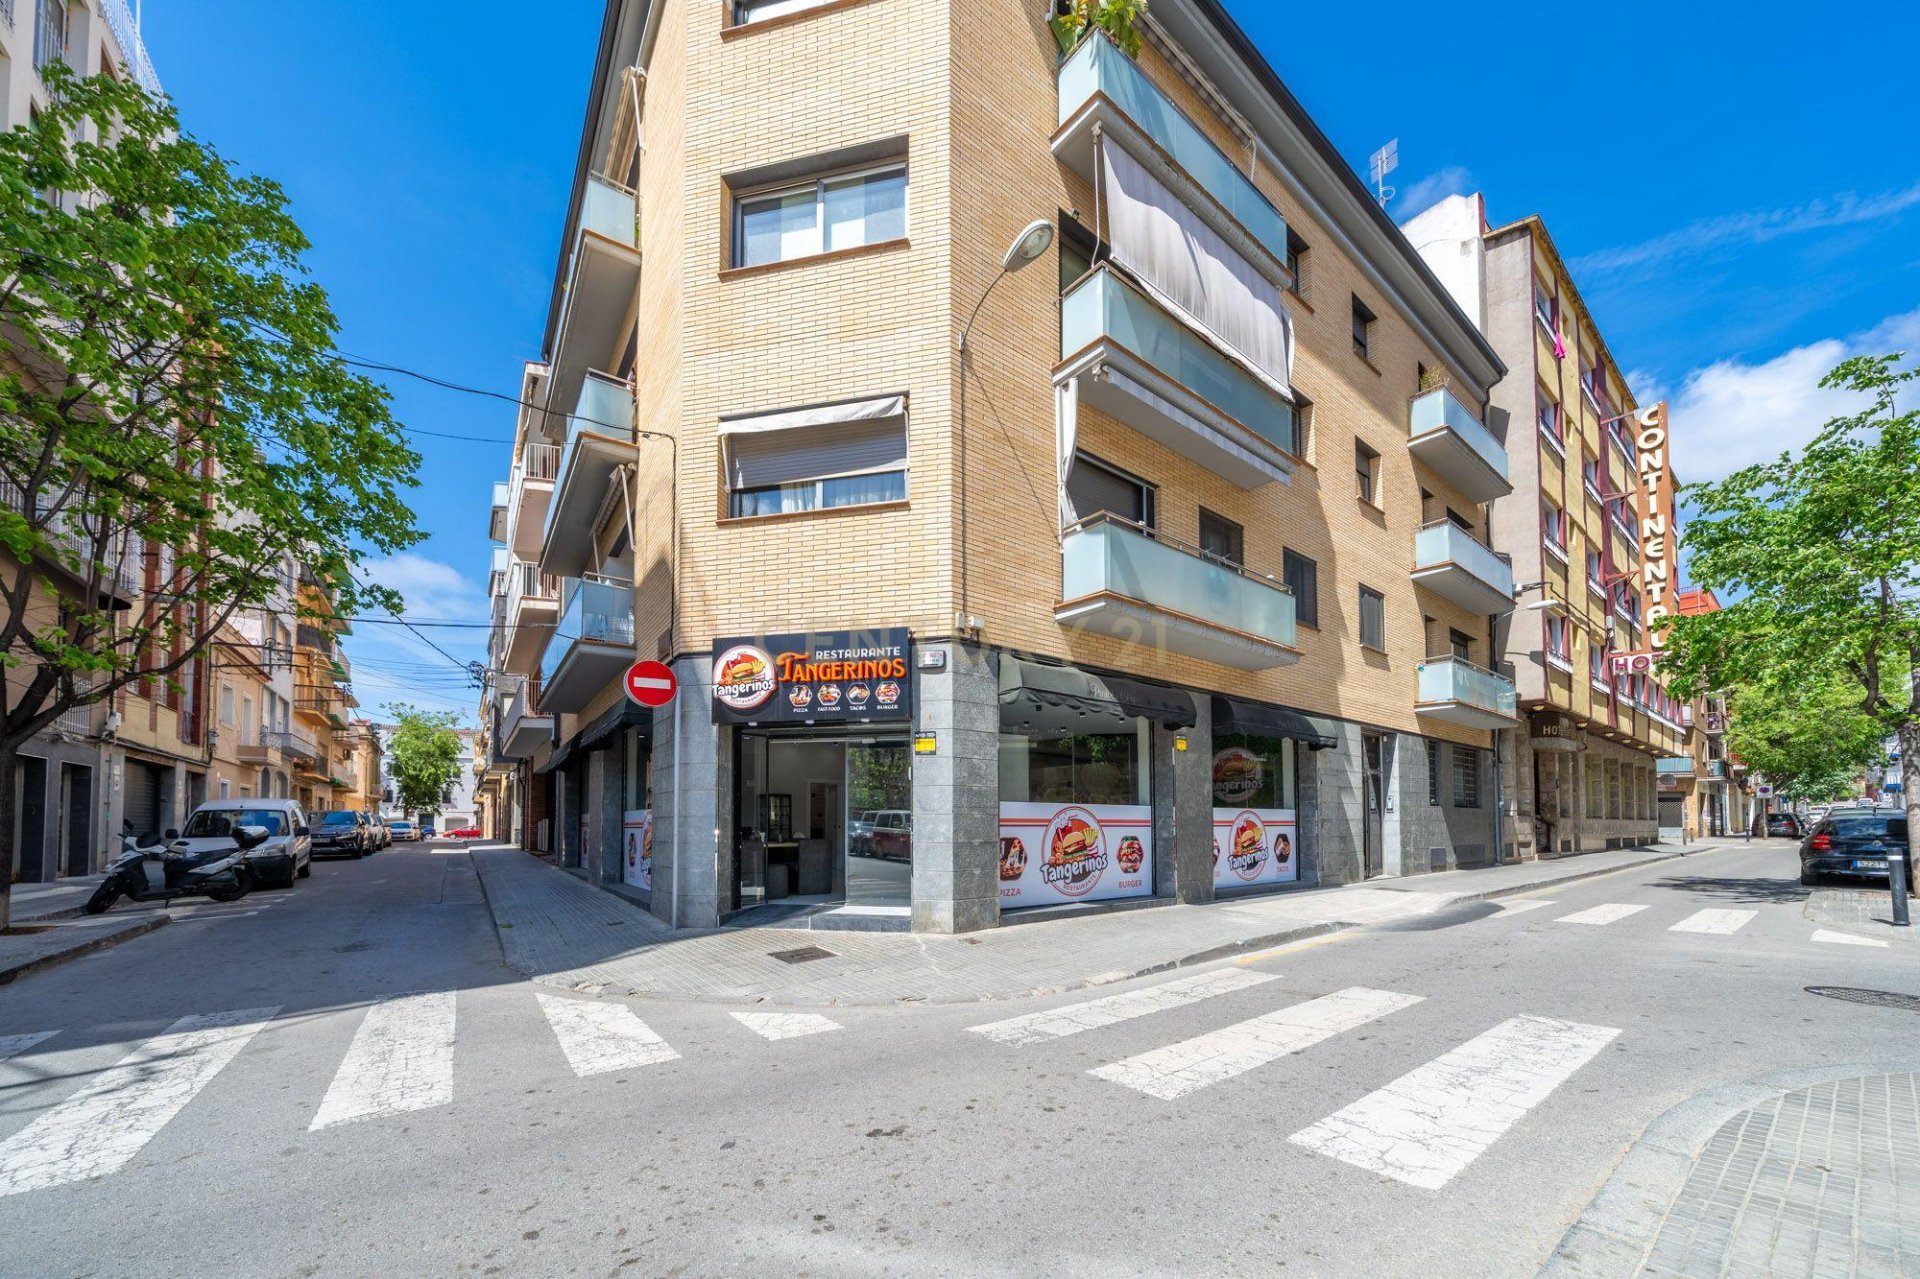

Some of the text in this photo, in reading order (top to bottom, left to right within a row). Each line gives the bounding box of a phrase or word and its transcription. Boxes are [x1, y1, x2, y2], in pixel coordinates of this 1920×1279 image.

[1638, 404, 1668, 648] CONTINENTAL
[815, 646, 901, 660] RESTAURANTE
[776, 651, 907, 682] TANGERINOS
[712, 680, 774, 698] Tangerinos
[1228, 847, 1269, 871] Tangerinos
[1040, 853, 1108, 884] Tangerinos
[1063, 873, 1096, 891] RESTAURANTE
[1118, 879, 1143, 889] BURGER
[999, 888, 1021, 897] PIZZA
